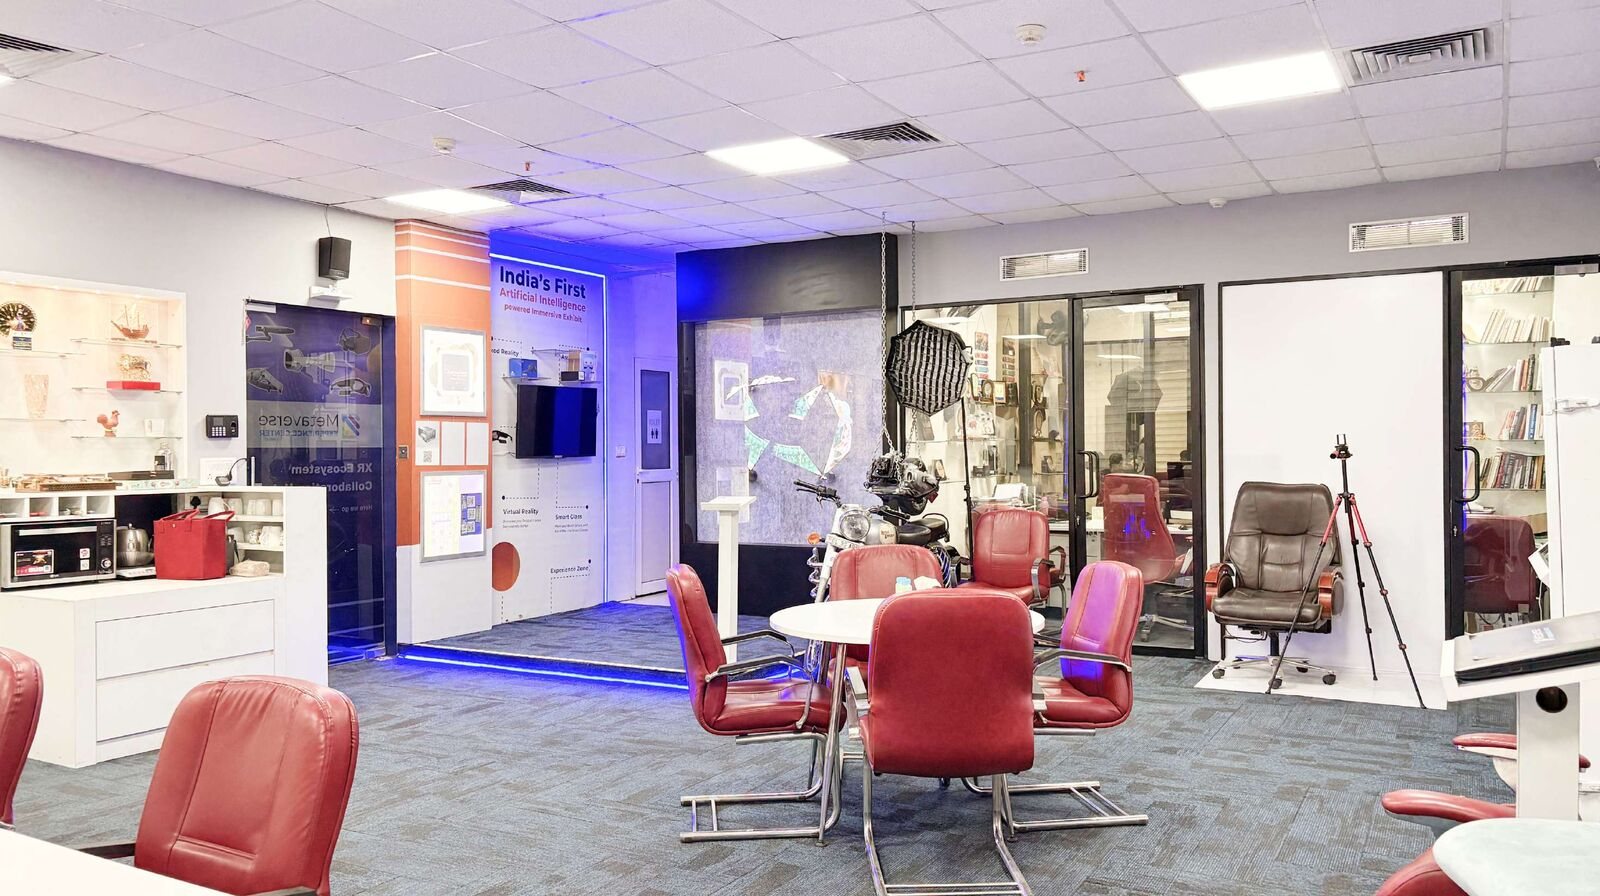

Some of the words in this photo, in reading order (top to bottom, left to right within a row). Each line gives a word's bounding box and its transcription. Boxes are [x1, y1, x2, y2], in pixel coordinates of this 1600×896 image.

[500, 266, 550, 291] India's
[555, 278, 586, 299] First
[500, 288, 537, 303] Artificial
[539, 295, 586, 312] Intelligence
[504, 304, 530, 314] powered
[531, 308, 562, 319] Immersive
[563, 314, 582, 323] Exhibit
